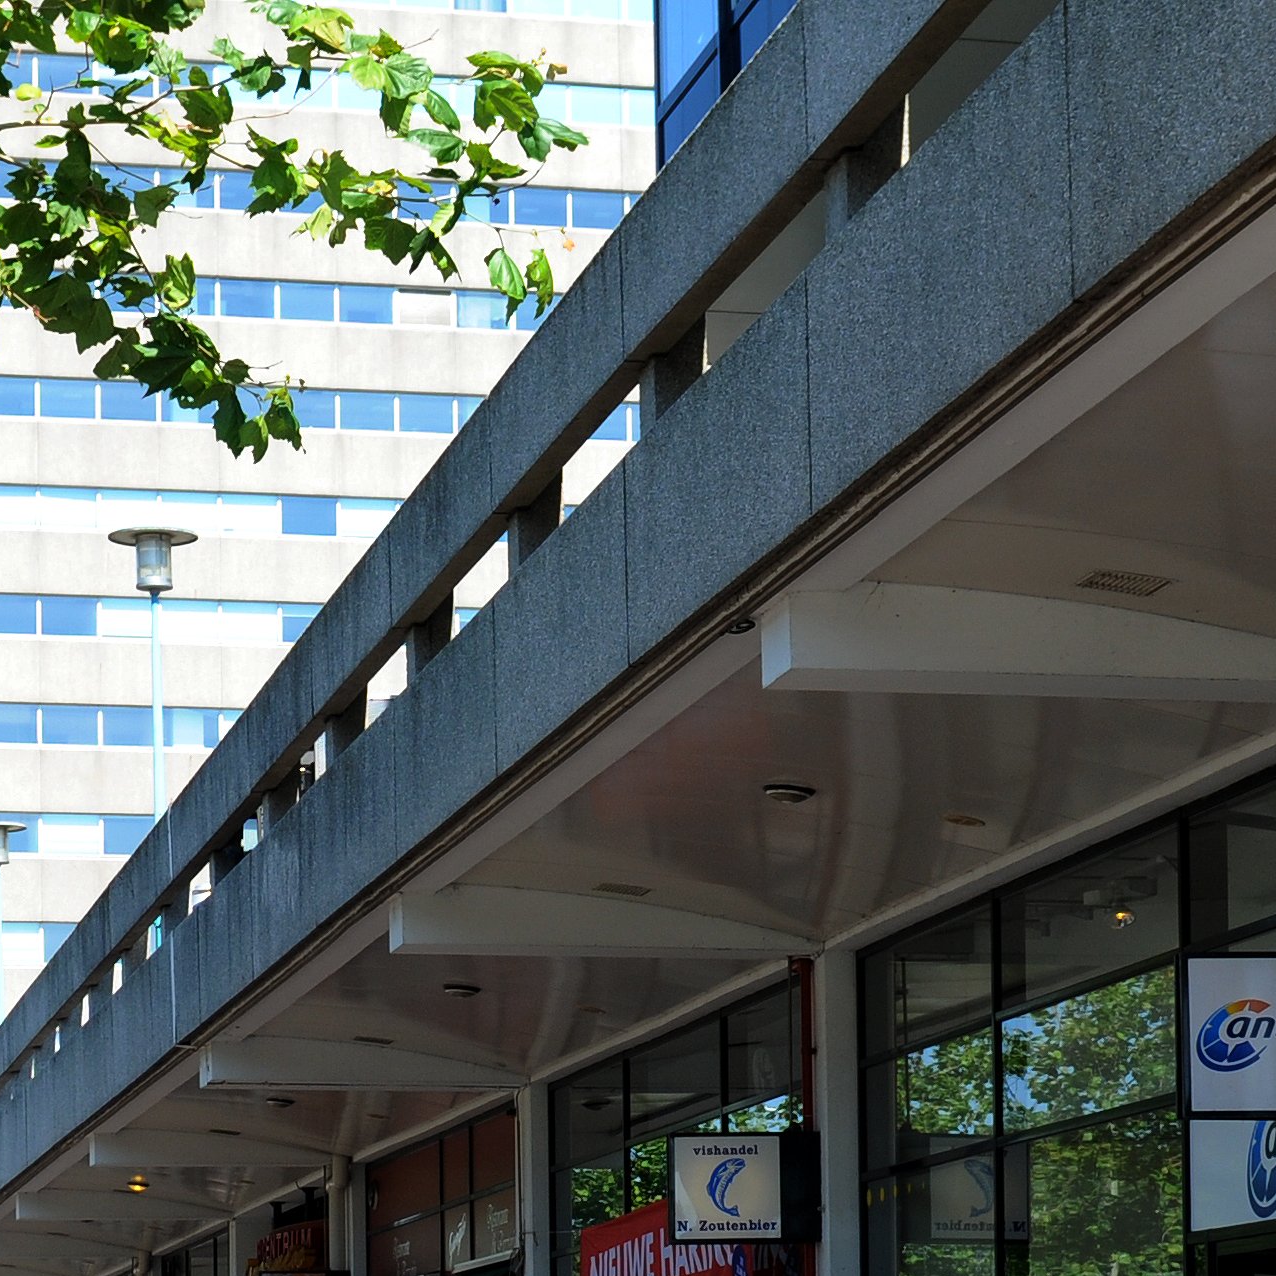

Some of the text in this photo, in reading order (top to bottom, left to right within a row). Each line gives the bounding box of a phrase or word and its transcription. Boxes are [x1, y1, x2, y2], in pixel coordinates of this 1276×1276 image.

[692, 1145, 759, 1156] vishandel
[677, 1219, 777, 1233] N. Zoutenbier
